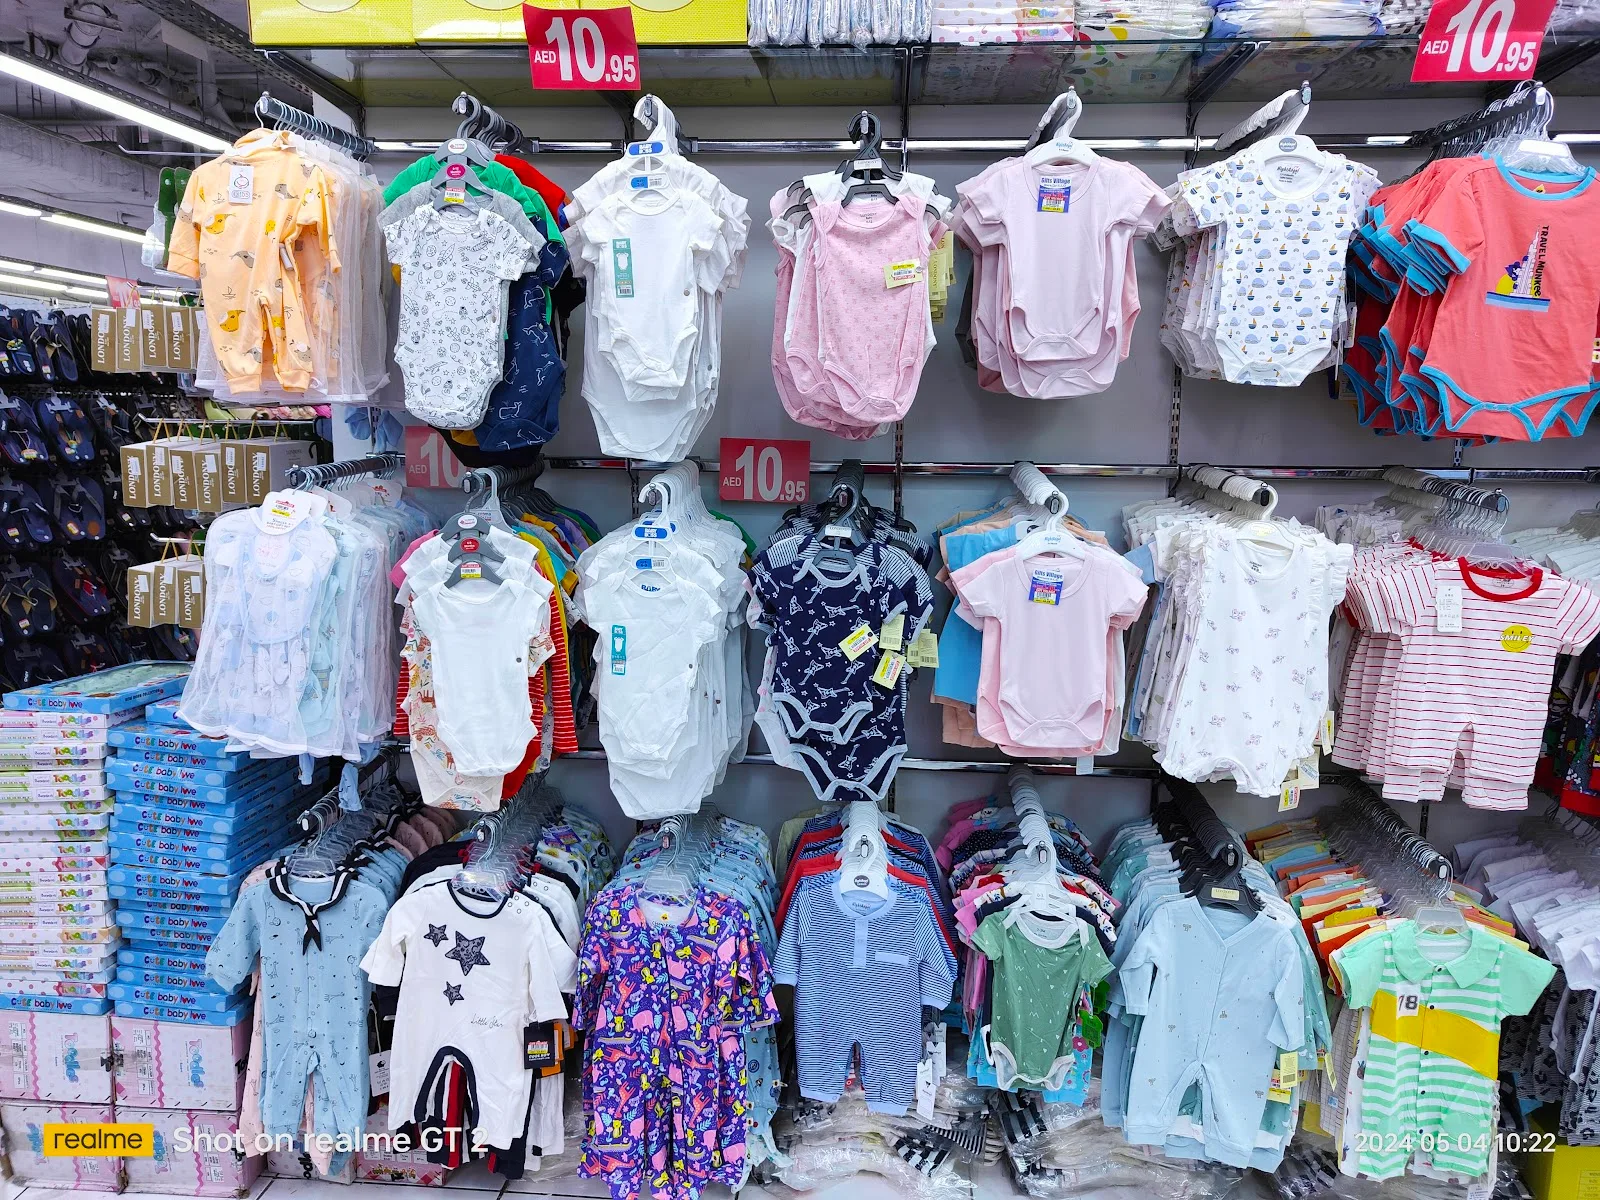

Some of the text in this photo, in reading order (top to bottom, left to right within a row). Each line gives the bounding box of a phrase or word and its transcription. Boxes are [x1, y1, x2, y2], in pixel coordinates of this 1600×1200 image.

[1422, 0, 1537, 73] AED 10.95
[534, 16, 636, 82] AED 10.95
[1538, 225, 1550, 259] TRAVEL
[408, 464, 428, 474] AED
[722, 445, 806, 501] AED 10.95
[159, 573, 167, 617] LONDONY
[184, 578, 192, 621] LONDONY
[1500, 634, 1535, 642] SMILEY
[48, 698, 67, 709] baby
[158, 738, 178, 749] baby
[158, 782, 178, 793] baby
[164, 814, 185, 825] baby
[161, 825, 181, 836] baby
[159, 841, 179, 851] baby
[162, 857, 182, 867] baby
[159, 876, 180, 887] baby
[160, 890, 182, 900] baby
[168, 917, 189, 928] baby
[173, 931, 194, 941] baby
[167, 958, 187, 969] baby
[167, 976, 187, 987] baby
[157, 993, 178, 1004] baby
[34, 999, 54, 1010] baby
[167, 1008, 188, 1019] baby
